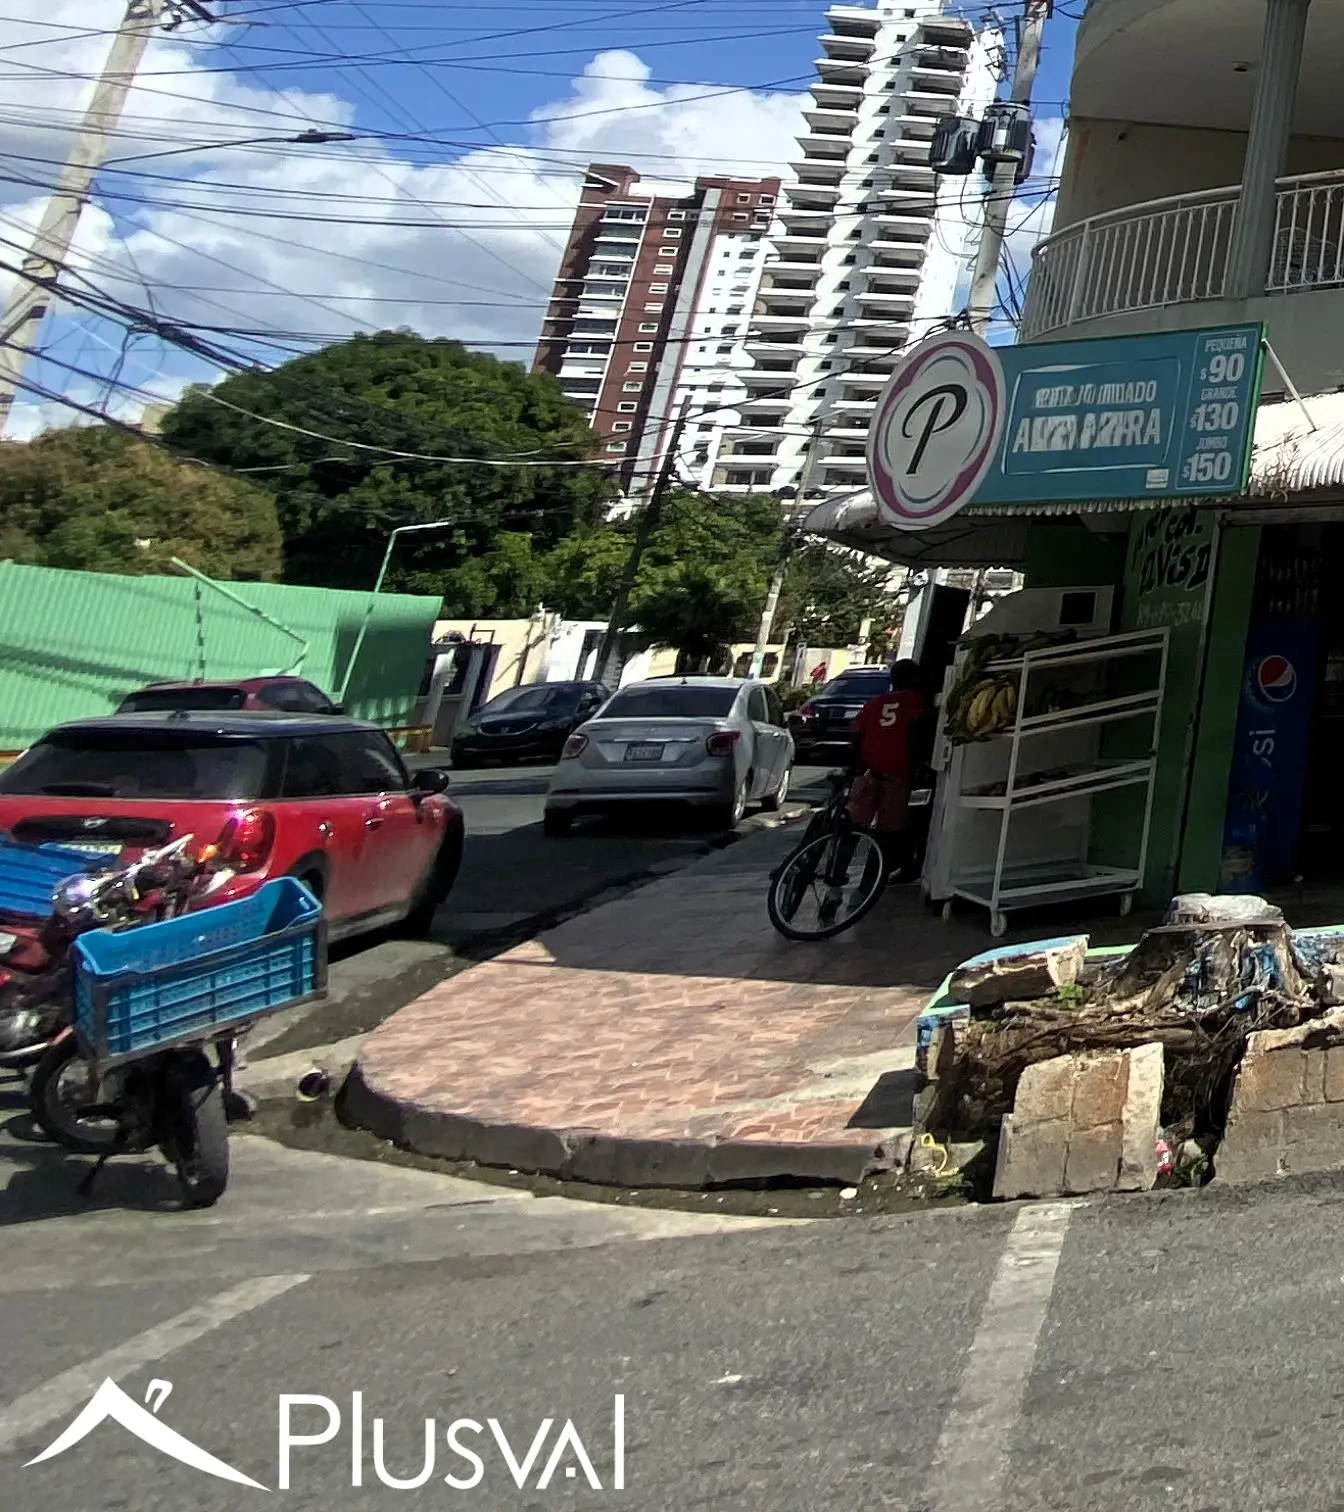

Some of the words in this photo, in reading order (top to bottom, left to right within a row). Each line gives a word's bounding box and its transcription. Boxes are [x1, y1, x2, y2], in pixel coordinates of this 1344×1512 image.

[902, 384, 968, 476] P
[1189, 402, 1240, 432] $130
[1181, 451, 1232, 482] $150
[878, 701, 901, 728] 5
